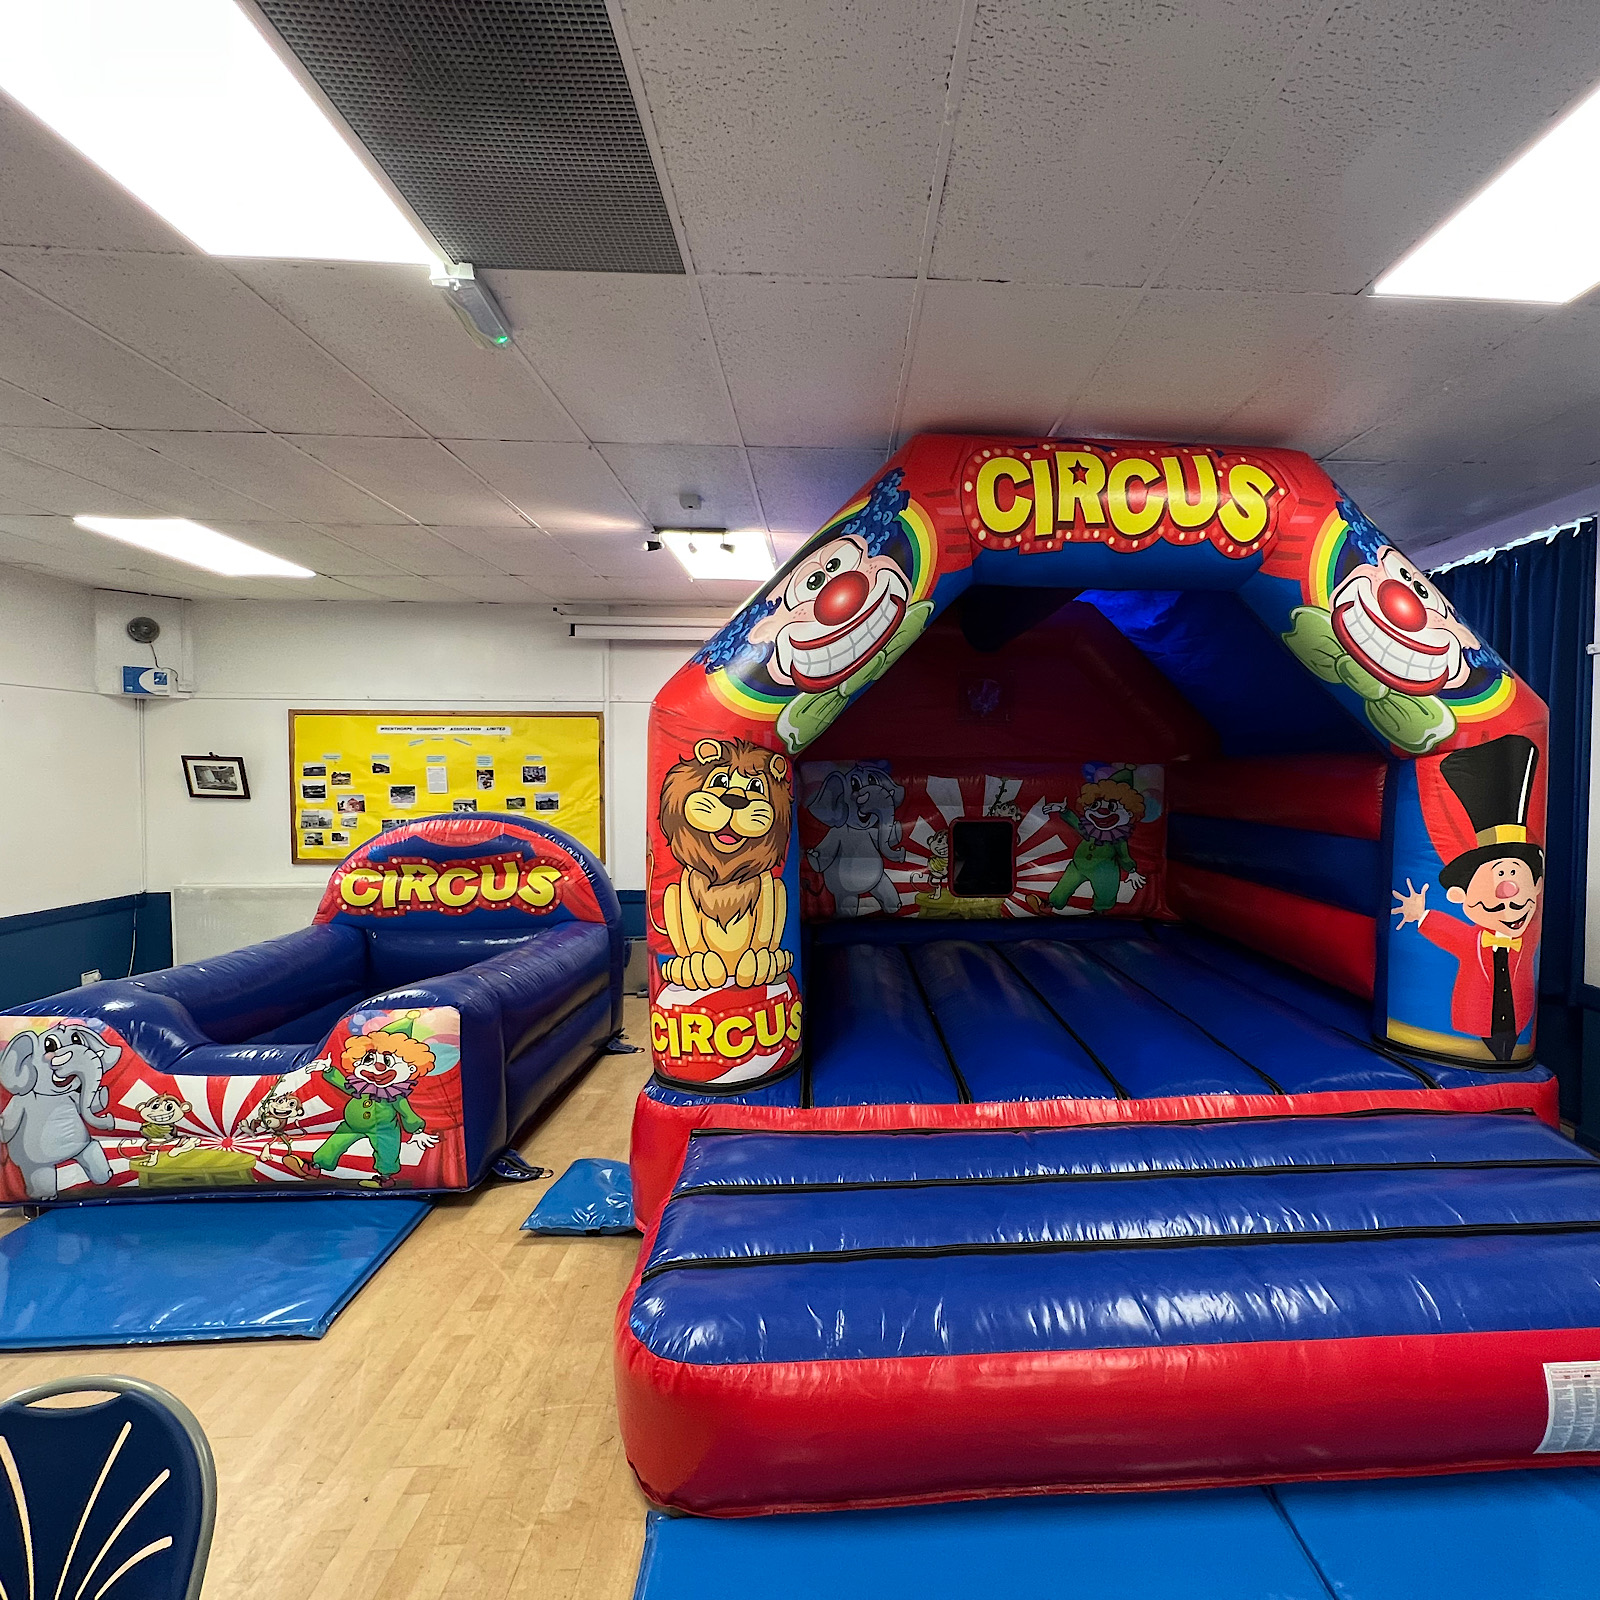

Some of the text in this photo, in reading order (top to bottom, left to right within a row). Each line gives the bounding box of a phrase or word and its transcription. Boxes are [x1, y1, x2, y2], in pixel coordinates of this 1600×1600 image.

[976, 450, 1277, 543] CIRCUS
[340, 862, 563, 909] CIRCUS
[651, 1000, 803, 1058] CIRCUS
